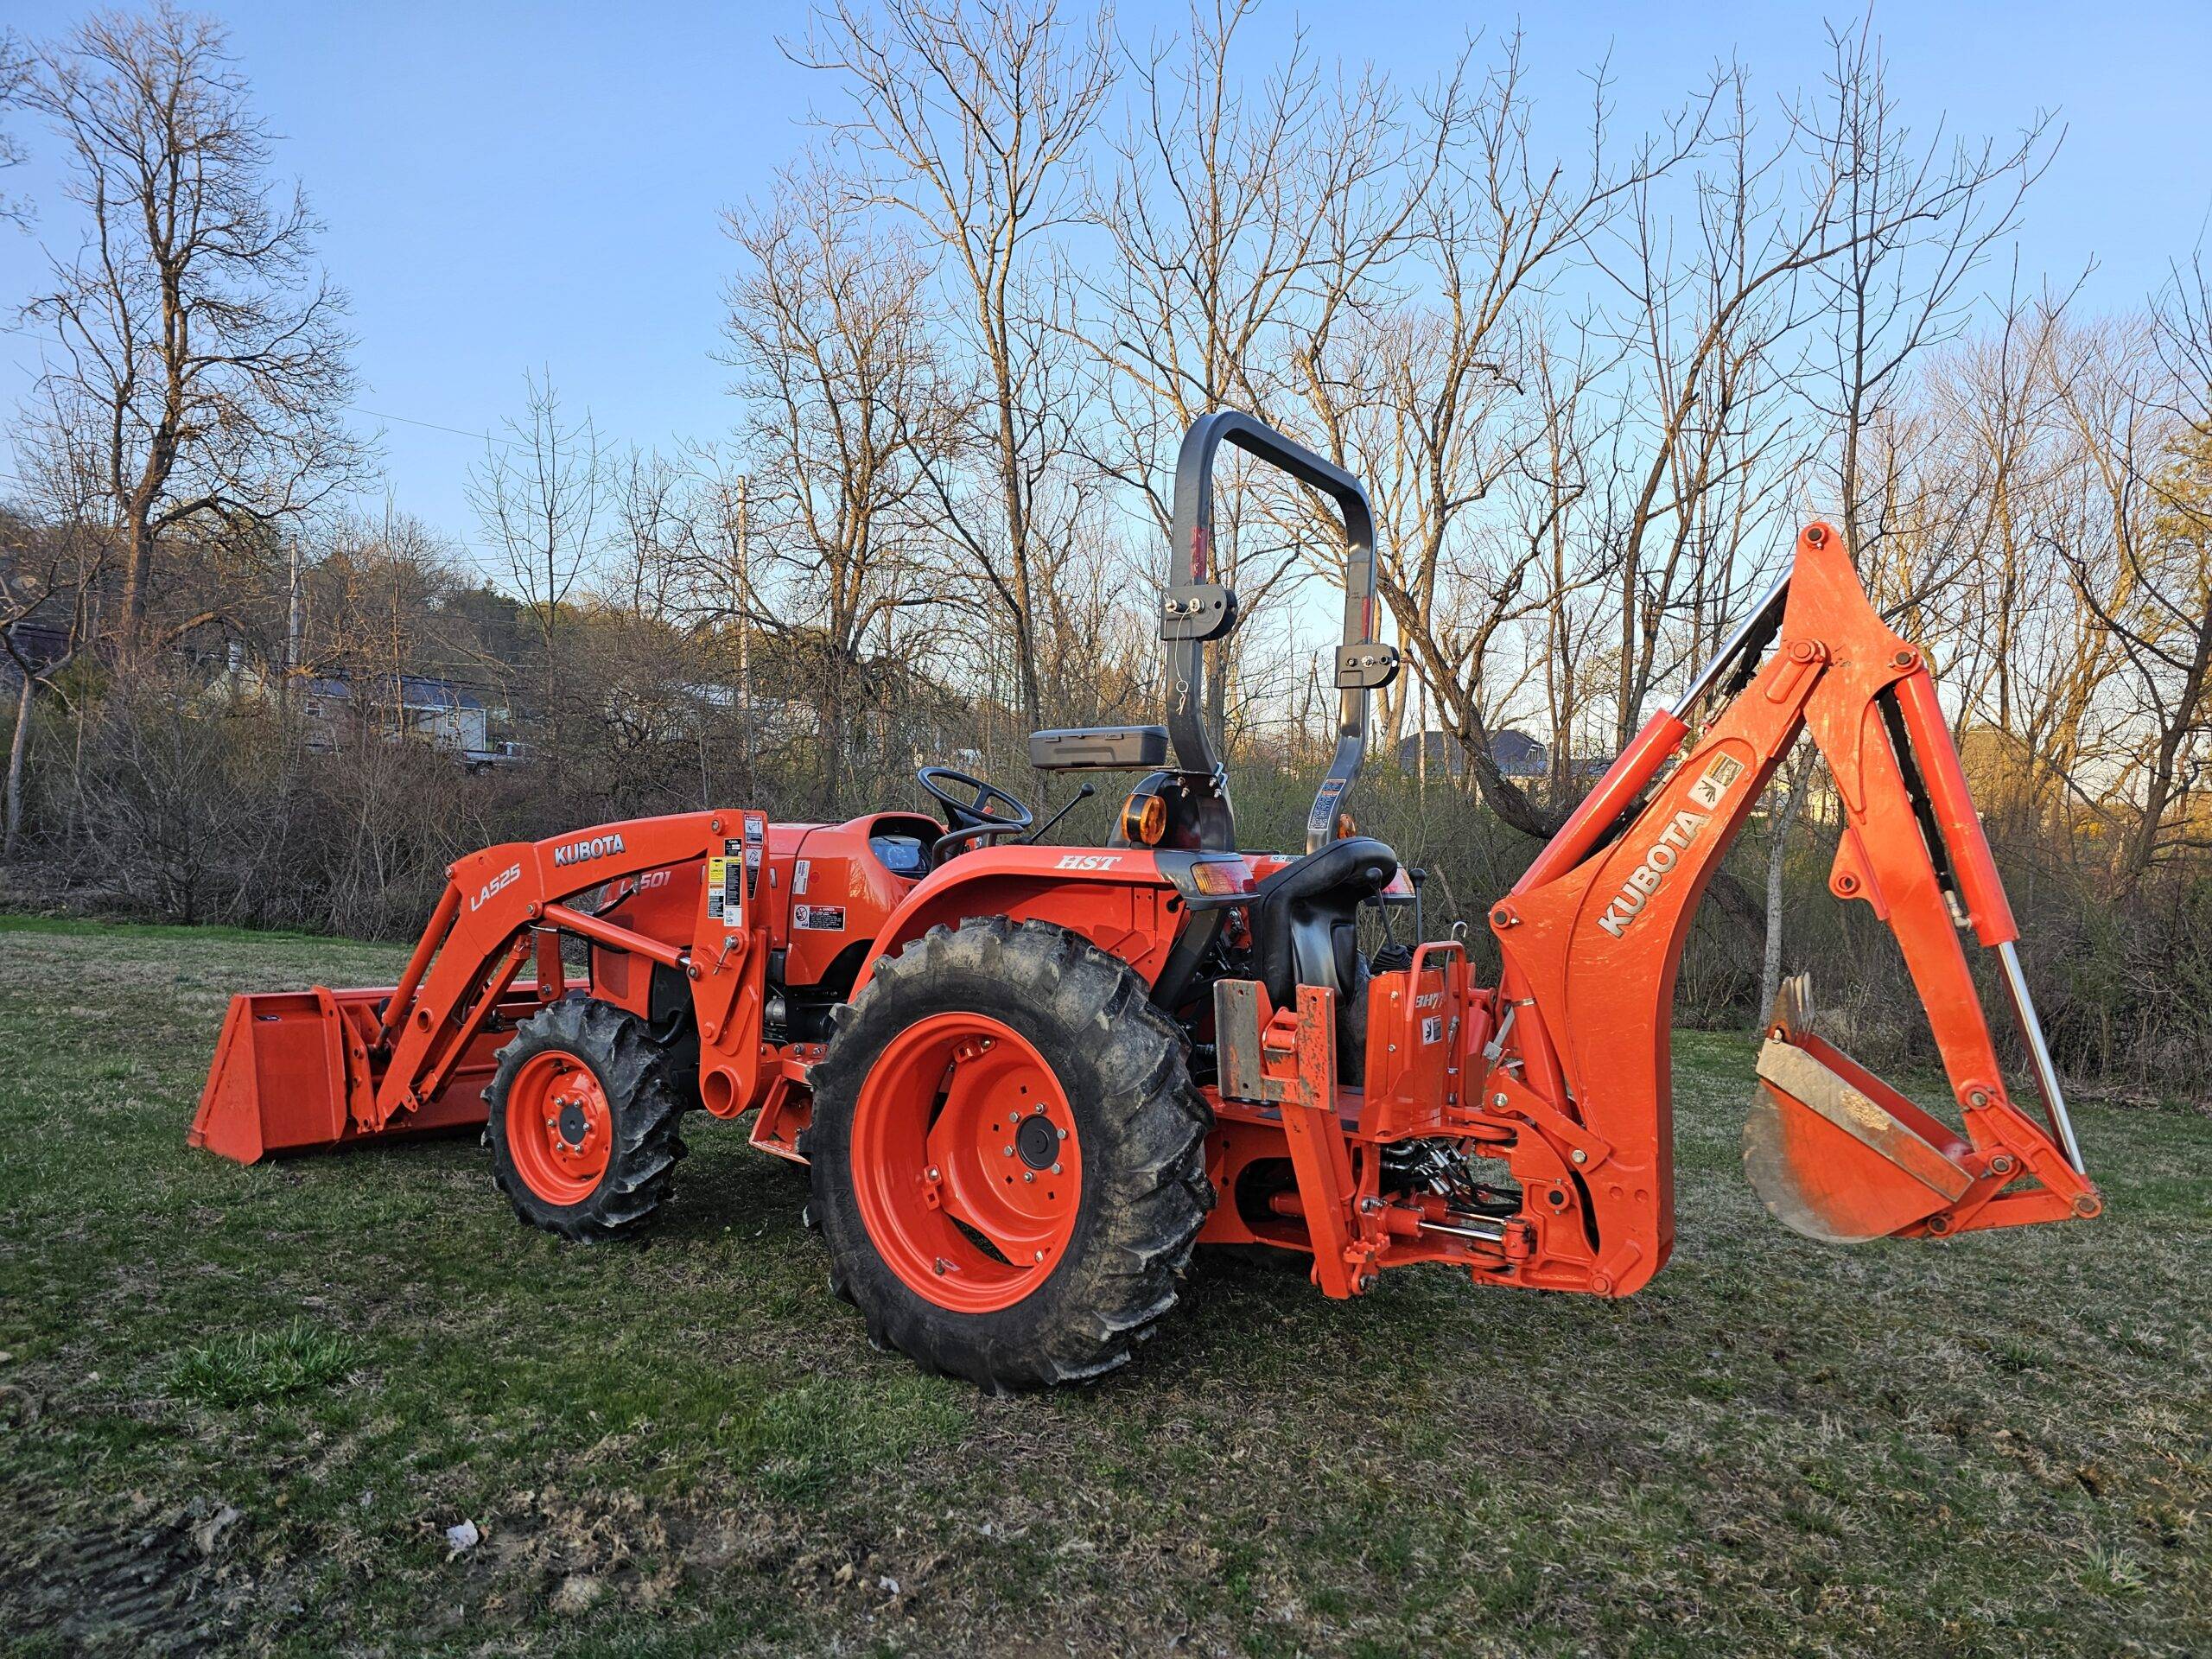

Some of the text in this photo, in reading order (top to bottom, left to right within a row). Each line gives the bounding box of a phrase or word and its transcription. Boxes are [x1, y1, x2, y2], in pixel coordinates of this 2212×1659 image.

[554, 833, 626, 868] KUBOTA
[1054, 855, 1122, 871] HST
[470, 862, 521, 912] LA525
[620, 871, 671, 895] L501
[1598, 810, 1710, 939] KUBOTA
